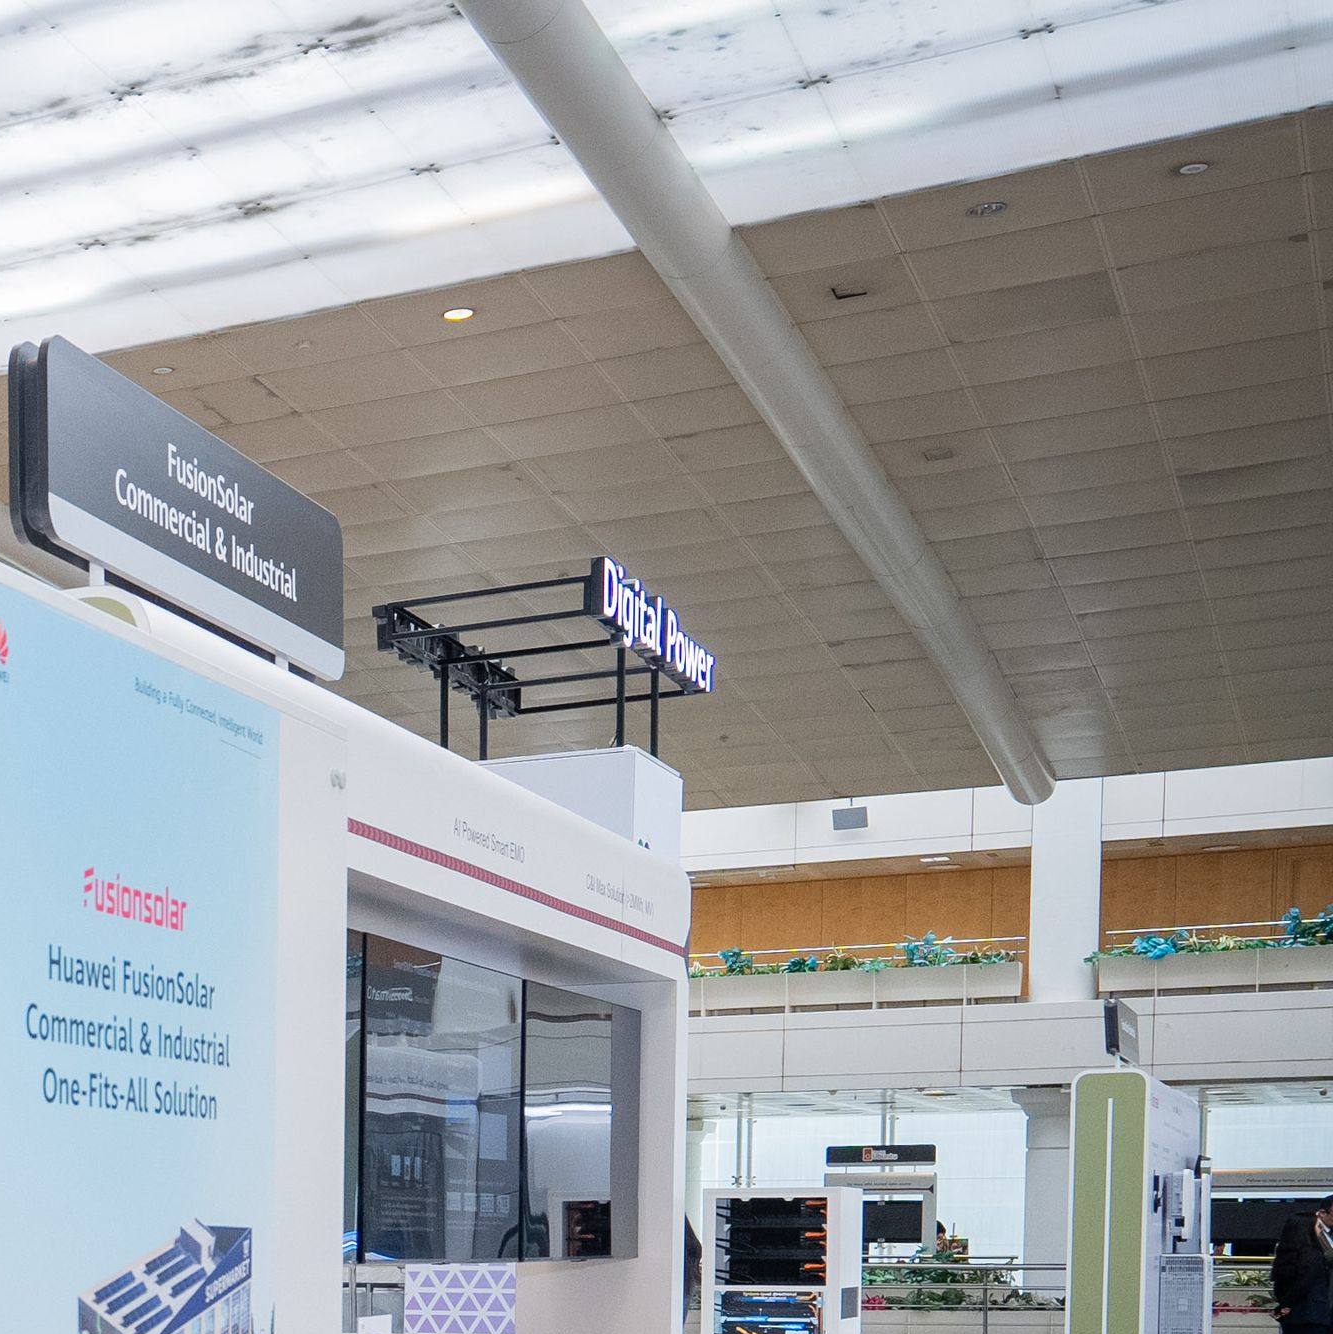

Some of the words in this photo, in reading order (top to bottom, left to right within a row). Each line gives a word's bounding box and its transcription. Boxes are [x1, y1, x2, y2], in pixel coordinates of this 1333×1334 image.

[167, 443, 254, 525] FusionSolar
[115, 469, 211, 554] Commercial
[214, 527, 227, 563] &
[232, 535, 297, 602] Industrial
[603, 556, 663, 656] Digital
[666, 608, 715, 693] Power
[135, 677, 161, 704] Building
[169, 691, 183, 714] Fully
[248, 726, 263, 745] World
[463, 821, 490, 849] Powered
[491, 833, 508, 857] Smart
[49, 944, 116, 992] Huawei
[123, 960, 215, 1010] FusionSolar
[26, 1003, 133, 1054] Commercial
[139, 1021, 152, 1056] &
[158, 1024, 230, 1068] Industrial
[43, 1068, 148, 1113] One-Fits-All
[155, 1081, 217, 1120] Solution
[205, 1258, 250, 1303] SUPERMARKET
